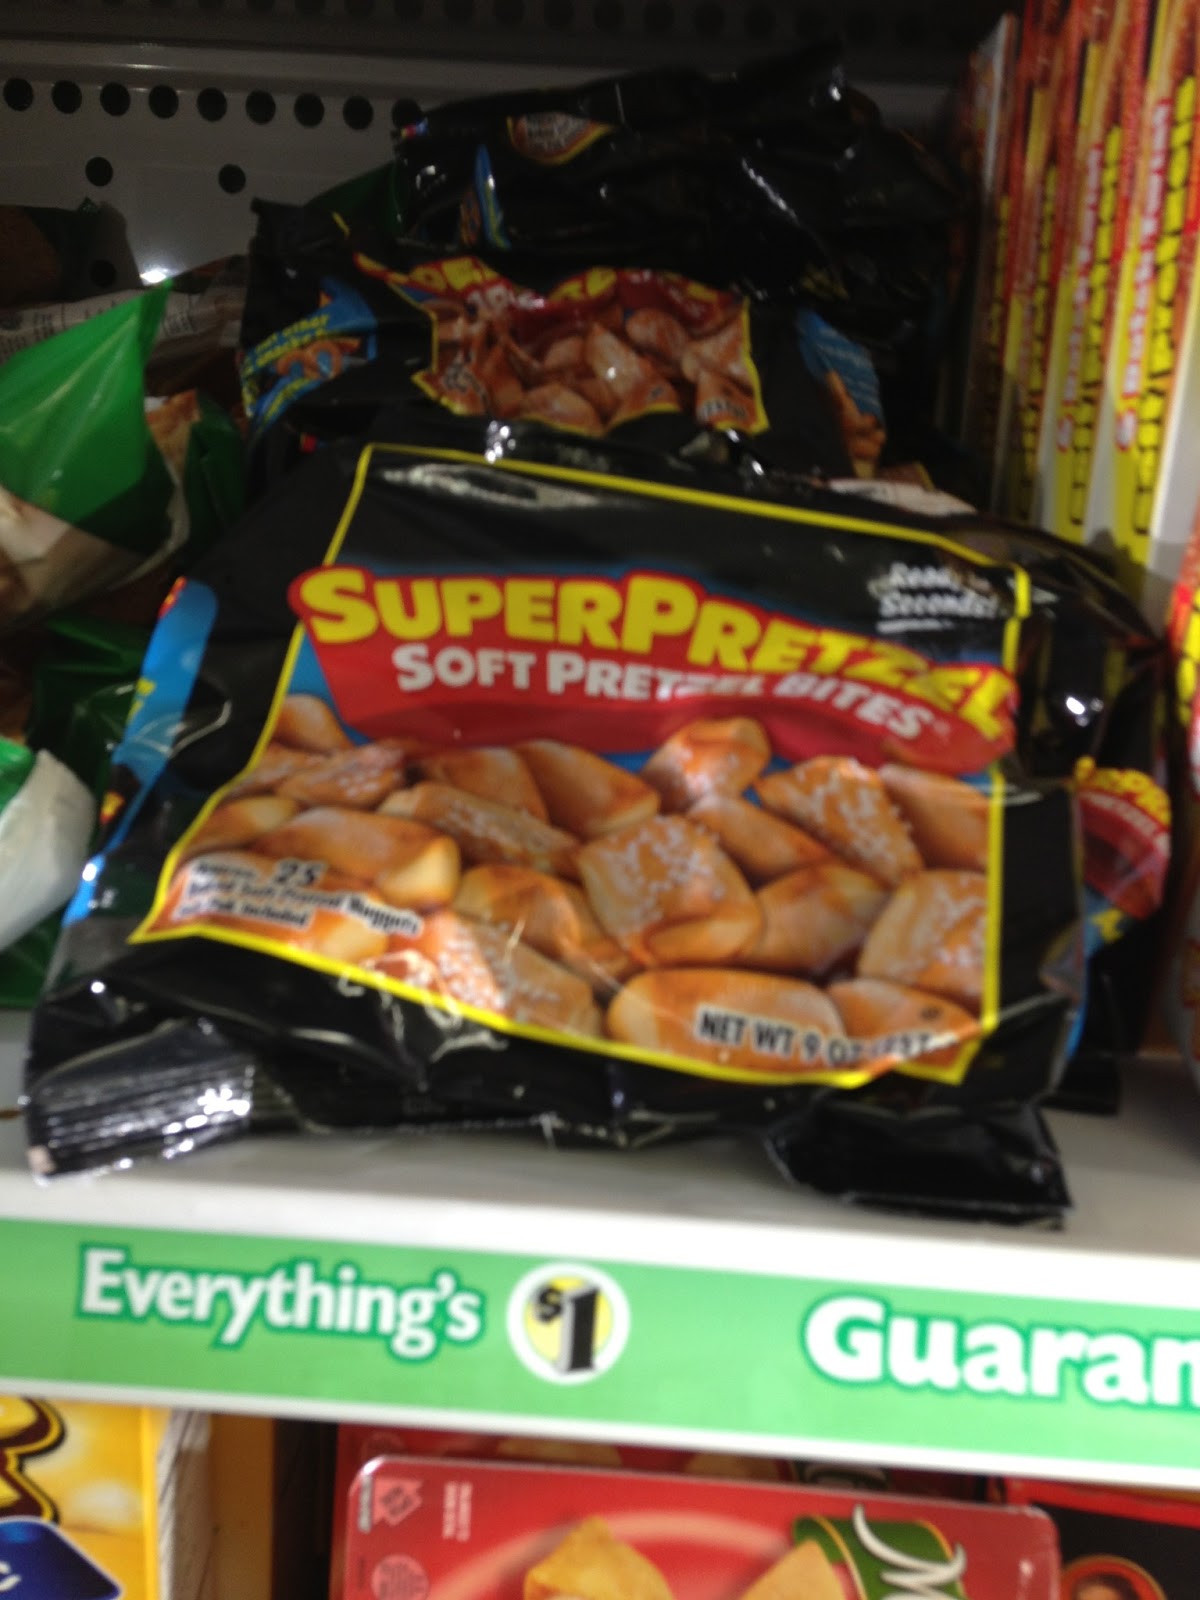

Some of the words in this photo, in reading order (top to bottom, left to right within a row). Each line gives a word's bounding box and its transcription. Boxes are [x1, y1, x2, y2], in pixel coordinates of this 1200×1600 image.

[391, 643, 537, 692] SOFT
[547, 651, 763, 702] PRETZEL
[772, 671, 936, 740] BITES
[274, 856, 324, 886] 25
[701, 1008, 747, 1047] NET
[754, 1020, 796, 1057] WT
[802, 1030, 823, 1063] 9
[81, 1246, 482, 1360] Everything's
[532, 1277, 600, 1375] $1
